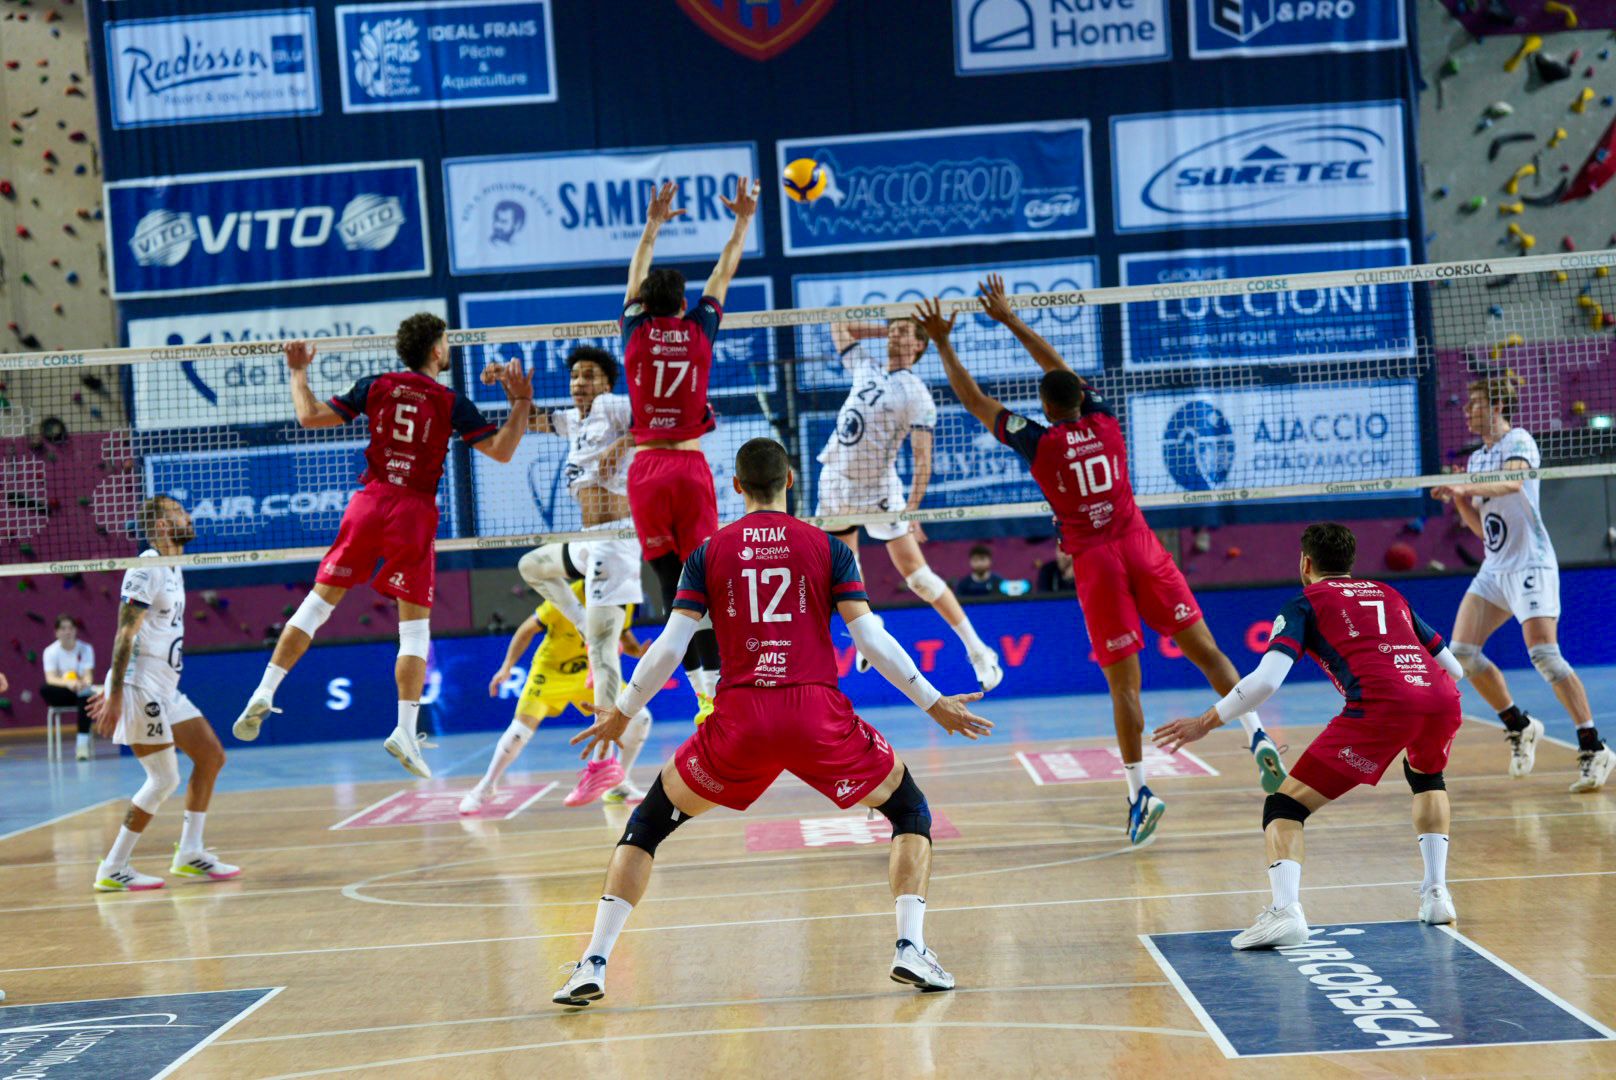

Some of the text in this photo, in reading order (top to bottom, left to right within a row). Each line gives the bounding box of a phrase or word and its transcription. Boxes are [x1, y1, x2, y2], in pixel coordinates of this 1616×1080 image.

[427, 24, 480, 41] IDEAL
[484, 20, 538, 38] FRAIS
[1051, 18, 1156, 48] Home
[122, 35, 268, 103] Radisson
[442, 73, 528, 91] Aquaculture
[1173, 159, 1373, 188] SURETEC
[1435, 263, 1492, 278] CORSICA
[1246, 279, 1289, 292] CORSE
[1030, 293, 1086, 308] CORSICA
[845, 306, 887, 320] CORSE
[661, 330, 690, 344] ROUX
[230, 342, 286, 357] CORSICA
[42, 353, 84, 368] CORSE
[223, 361, 267, 387] de
[652, 360, 690, 398] 17
[392, 403, 418, 443] 5
[1253, 413, 1389, 443] AJACCIO
[1066, 427, 1097, 445] BALA
[386, 459, 411, 470] AVIS
[1069, 454, 1113, 496] 10
[1469, 470, 1524, 484] Gamm vert
[1326, 481, 1380, 494] Gamm vert
[1183, 491, 1237, 503] Gamm vert
[190, 495, 255, 520] AIR
[900, 510, 953, 522] Gamm vert
[743, 526, 787, 542] PATAK
[476, 536, 532, 549] Gamm vert
[755, 546, 790, 555] FORMA
[50, 561, 104, 573] Gamm vert
[193, 553, 247, 567] Gamm vert
[741, 567, 793, 623] 12
[1358, 600, 1388, 635] 7
[757, 651, 787, 665] AVIS
[1393, 654, 1423, 665] AVIS
[147, 722, 163, 737] 24
[1298, 962, 1454, 1046] CORSICA
